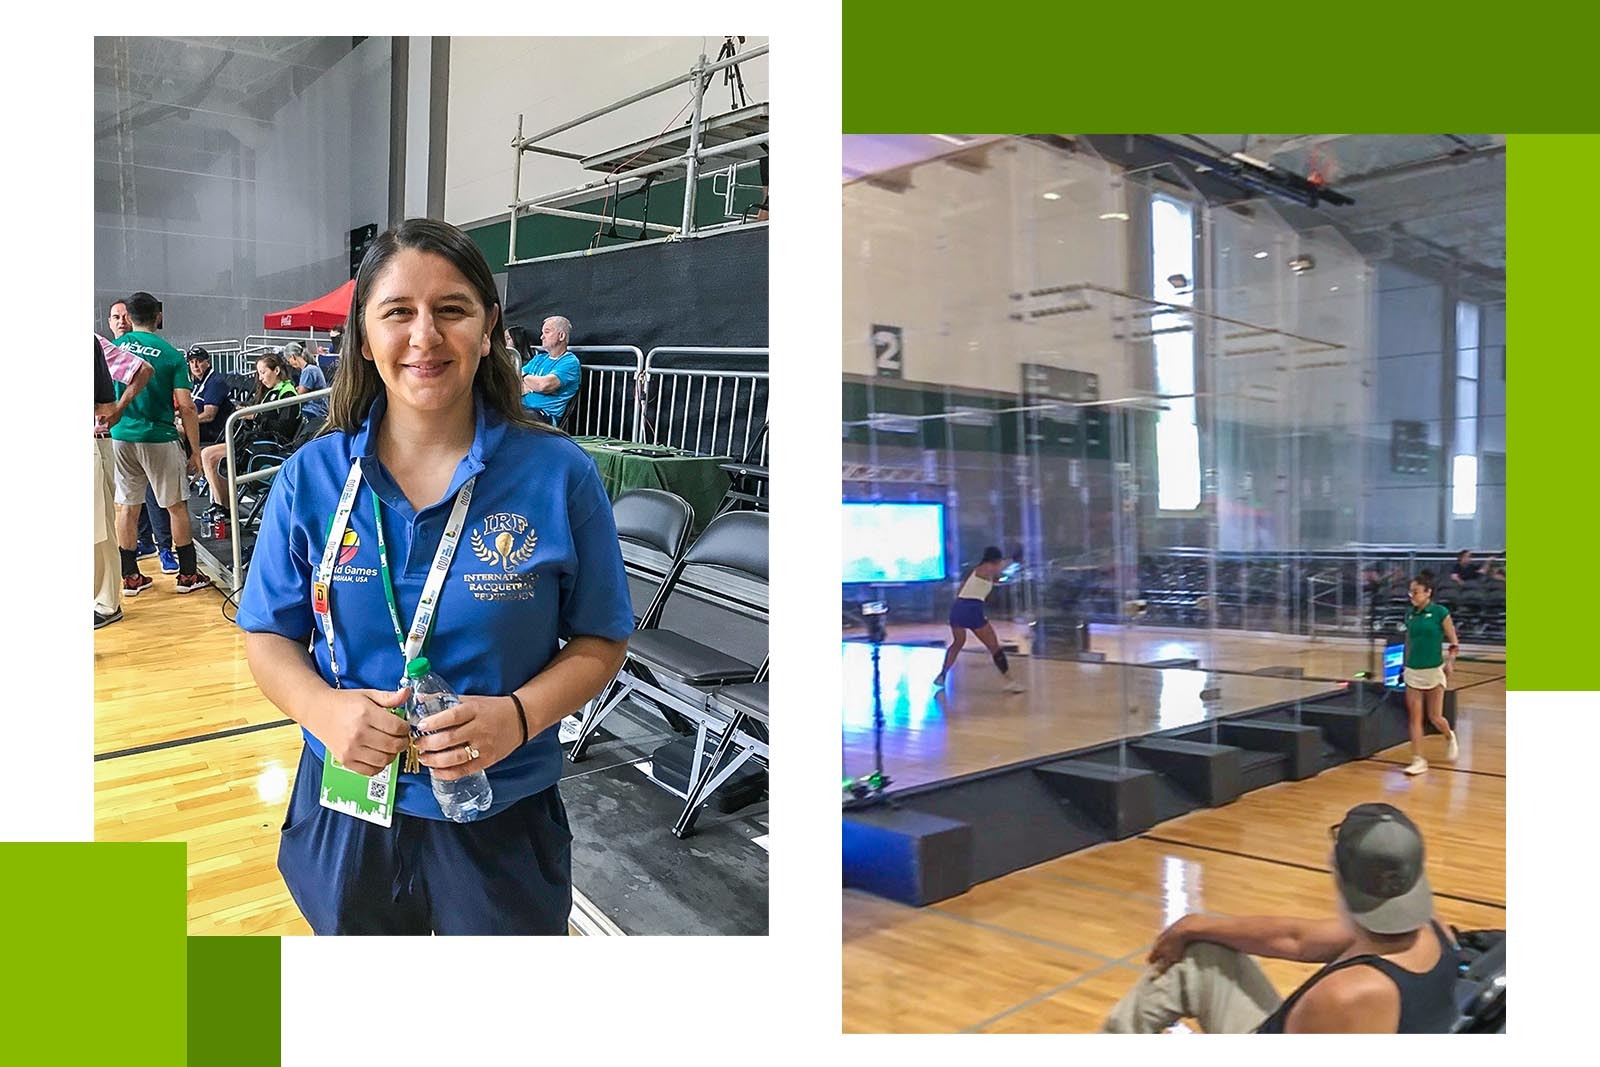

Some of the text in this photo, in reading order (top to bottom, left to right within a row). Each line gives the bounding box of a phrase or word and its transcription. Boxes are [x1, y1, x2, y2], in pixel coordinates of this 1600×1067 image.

[872, 331, 899, 369] 2
[484, 512, 529, 536] IRF
[344, 565, 378, 577] Games
